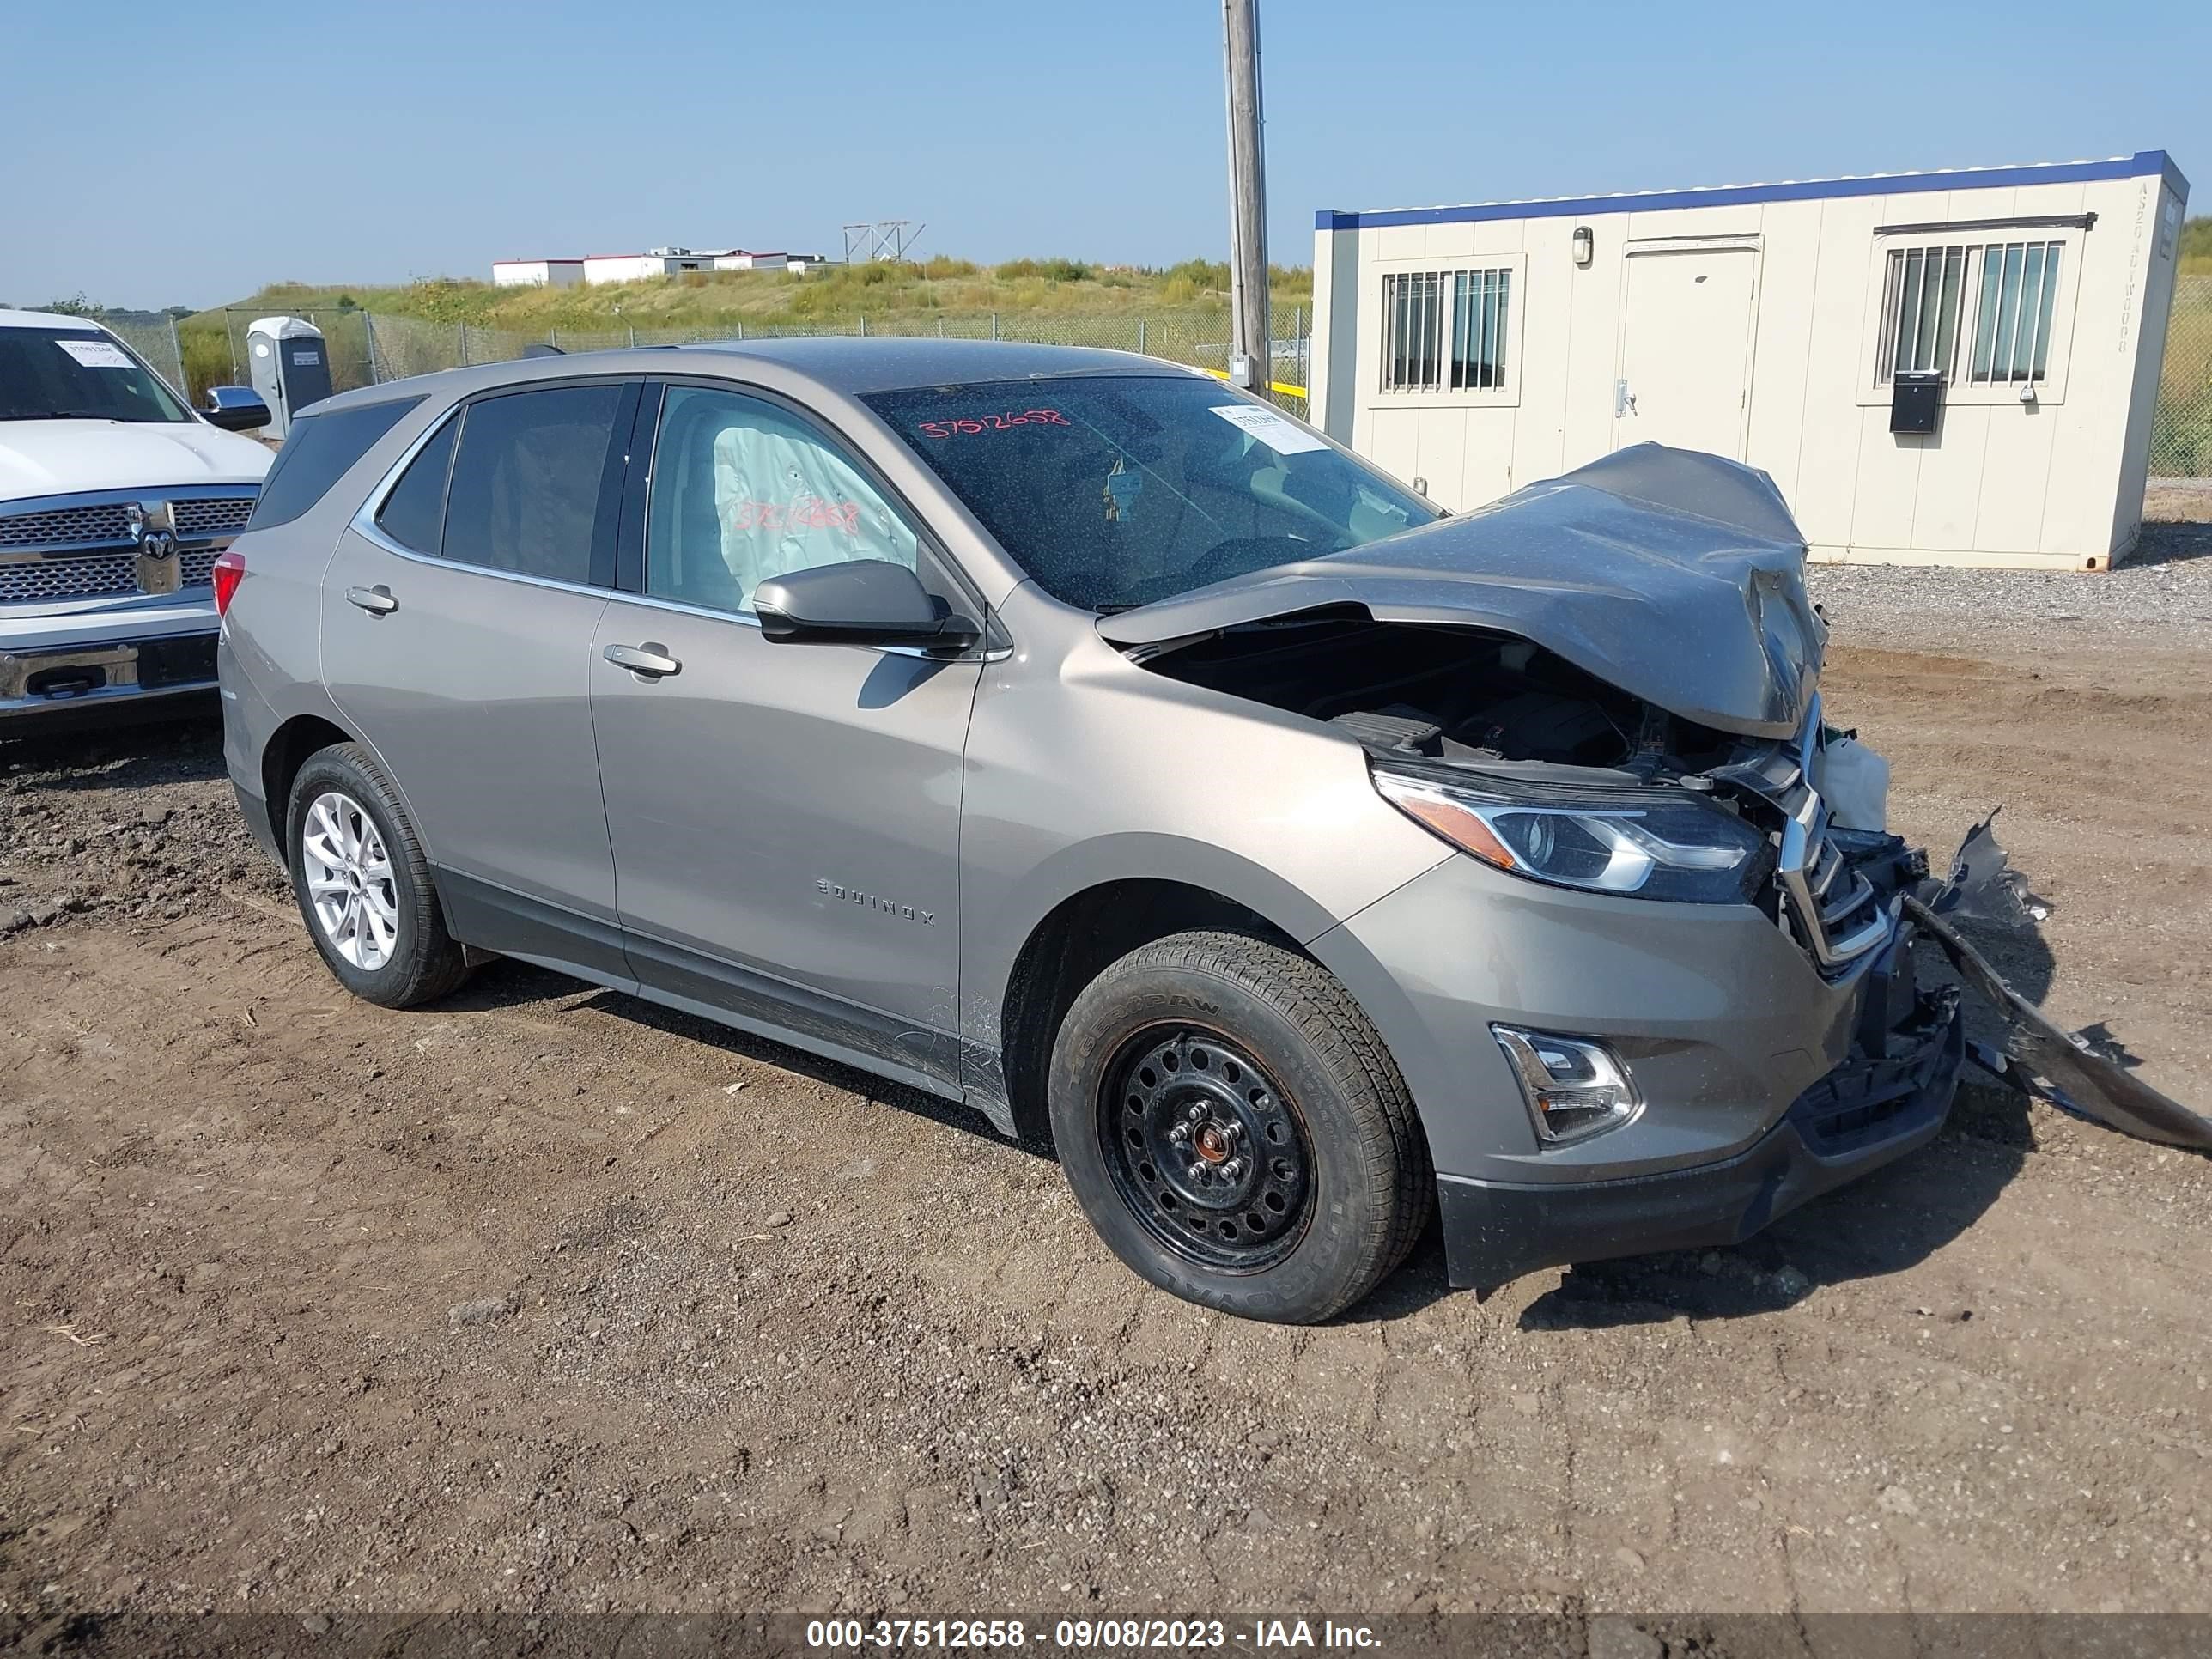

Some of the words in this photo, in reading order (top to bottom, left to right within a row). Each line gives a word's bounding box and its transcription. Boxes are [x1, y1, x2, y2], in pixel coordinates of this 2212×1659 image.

[919, 410, 1071, 438] 37512658
[817, 878, 935, 927] EQUINOX
[1142, 993, 1220, 1016] PAW
